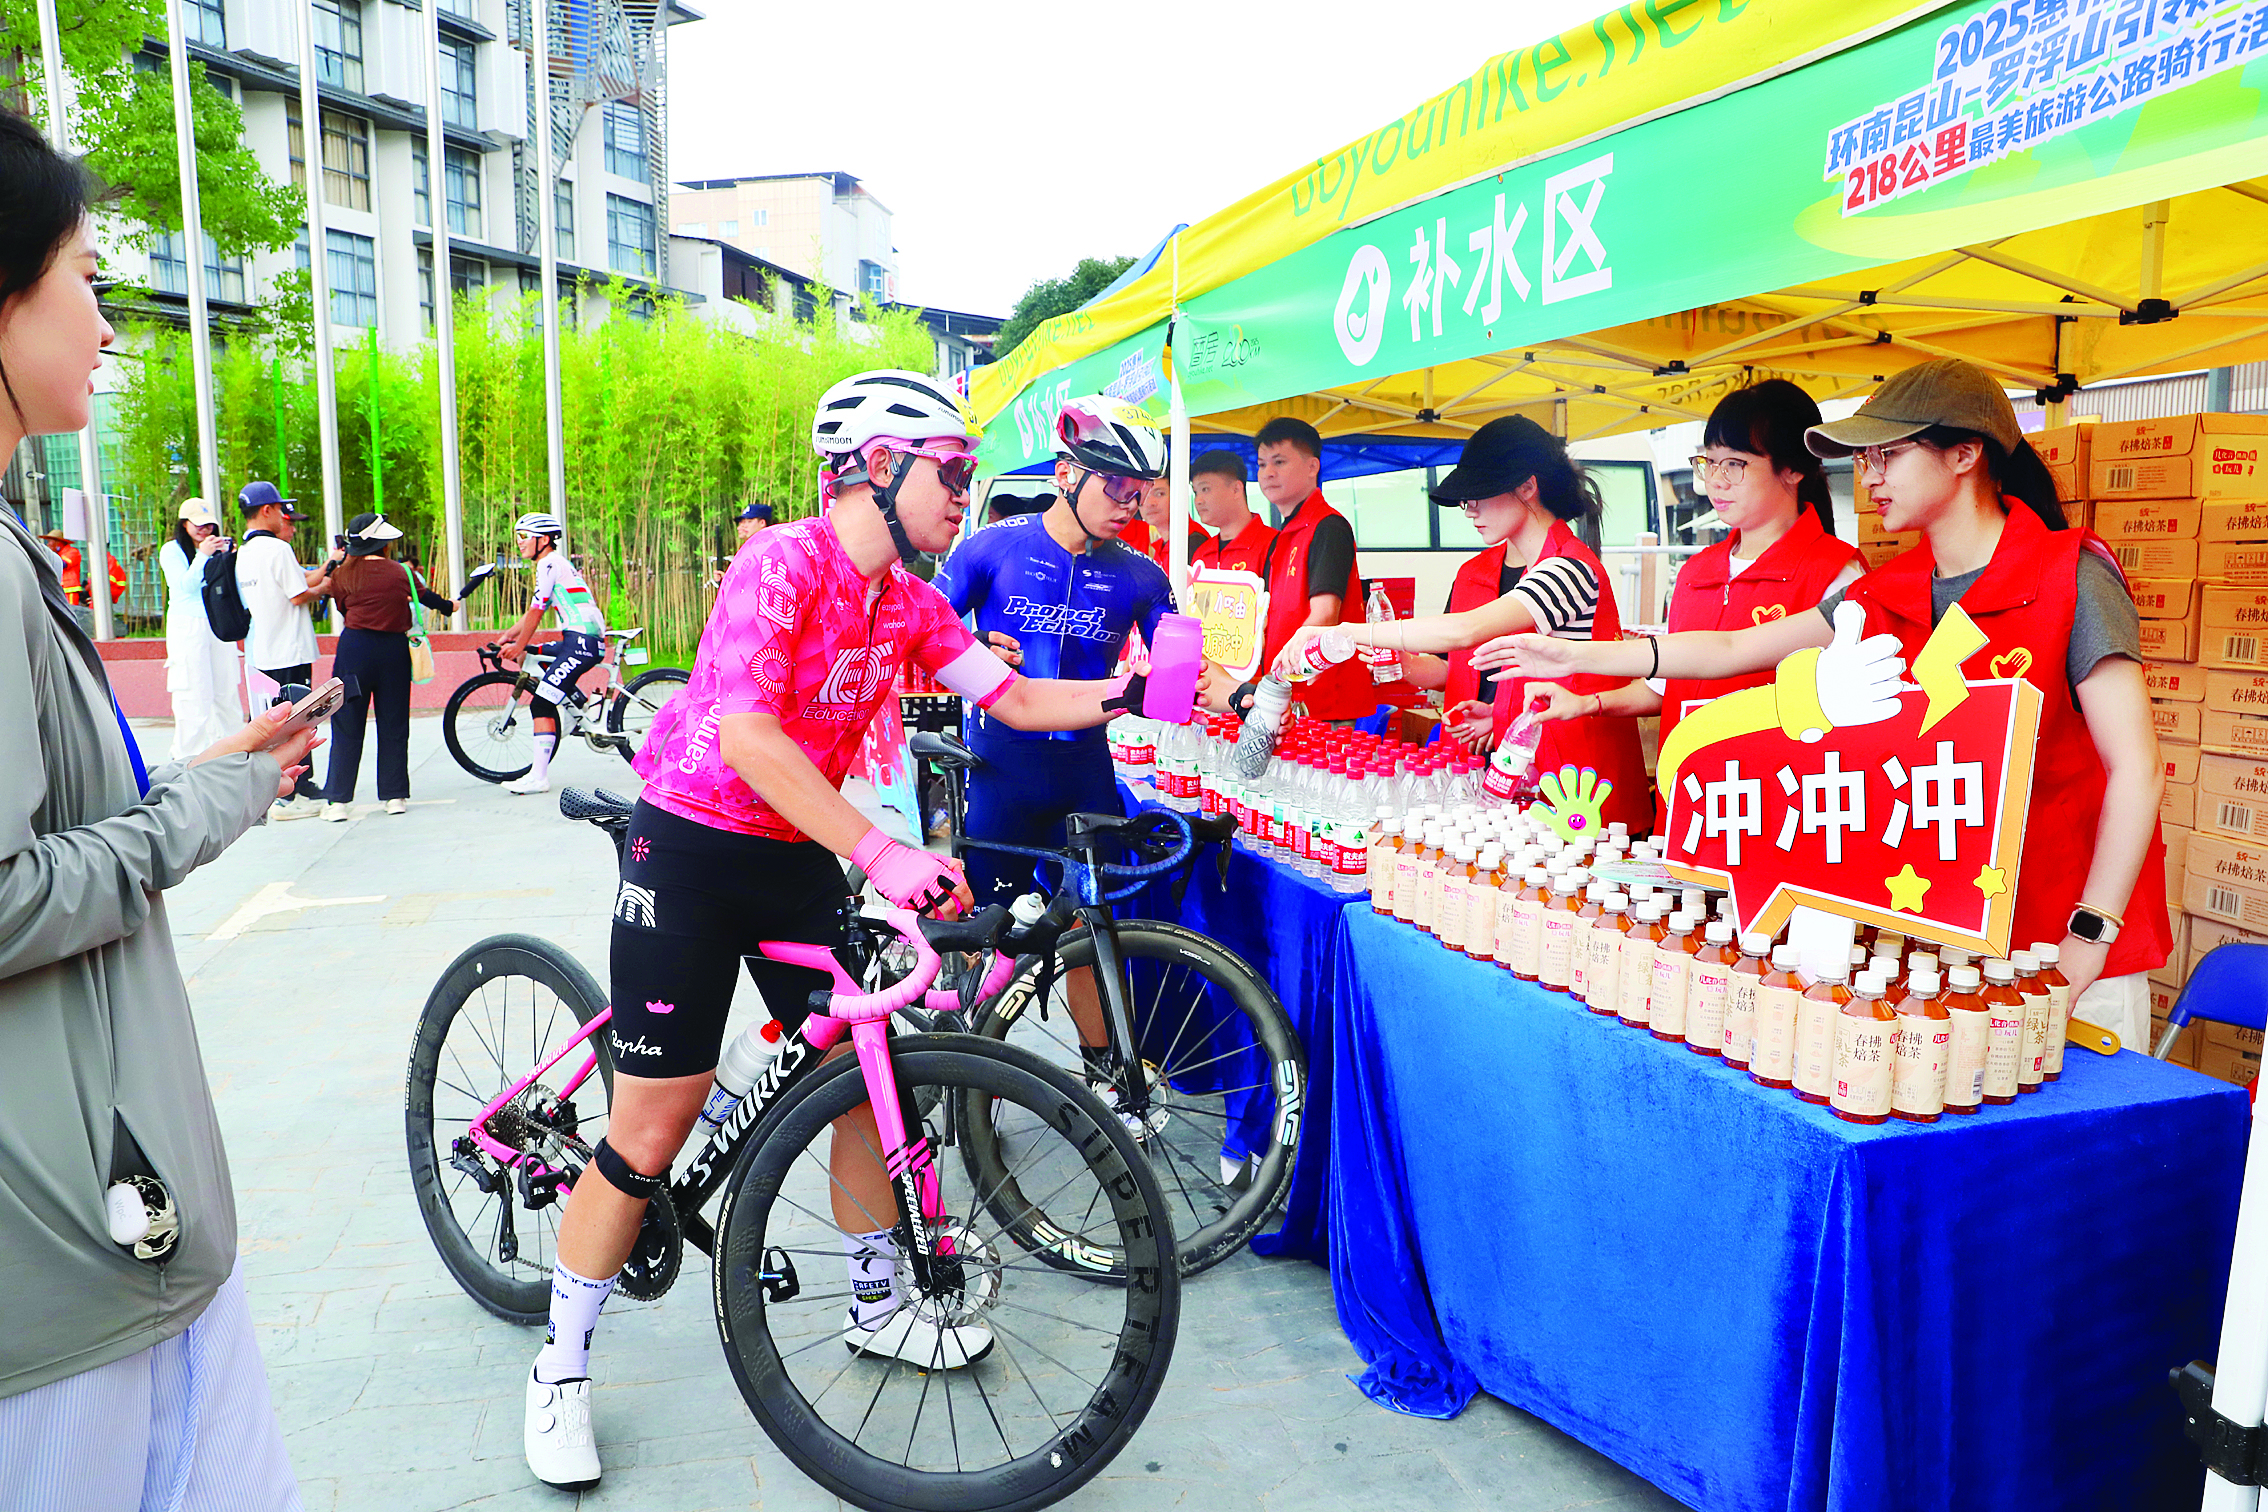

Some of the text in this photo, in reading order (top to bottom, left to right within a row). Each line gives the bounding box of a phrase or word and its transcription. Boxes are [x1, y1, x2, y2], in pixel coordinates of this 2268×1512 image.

[1402, 152, 1614, 342] 补水区
[2120, 437, 2162, 453] 春拂焙茶
[2123, 519, 2166, 533] 春拂焙茶
[1003, 595, 1106, 623] Project
[1213, 588, 1247, 619] 加油
[882, 619, 906, 629] wahoo
[1020, 615, 1121, 644] Echelon
[547, 656, 582, 687] BORA
[801, 705, 870, 723] Education
[1681, 740, 1985, 867] 冲冲冲
[611, 1029, 663, 1059] Rapha
[1854, 1033, 1882, 1048] 春拂
[1896, 1043, 1922, 1059] 焙茶
[1897, 1029, 1923, 1046] 春拂
[524, 1040, 570, 1083] SPECIALIZED
[1853, 1047, 1881, 1062] 焙茶
[692, 1040, 806, 1188] S-WORKS
[901, 1170, 929, 1256] SPECIALIZED
[713, 1245, 723, 1276] PRIX
[713, 1276, 725, 1318] GRAND
